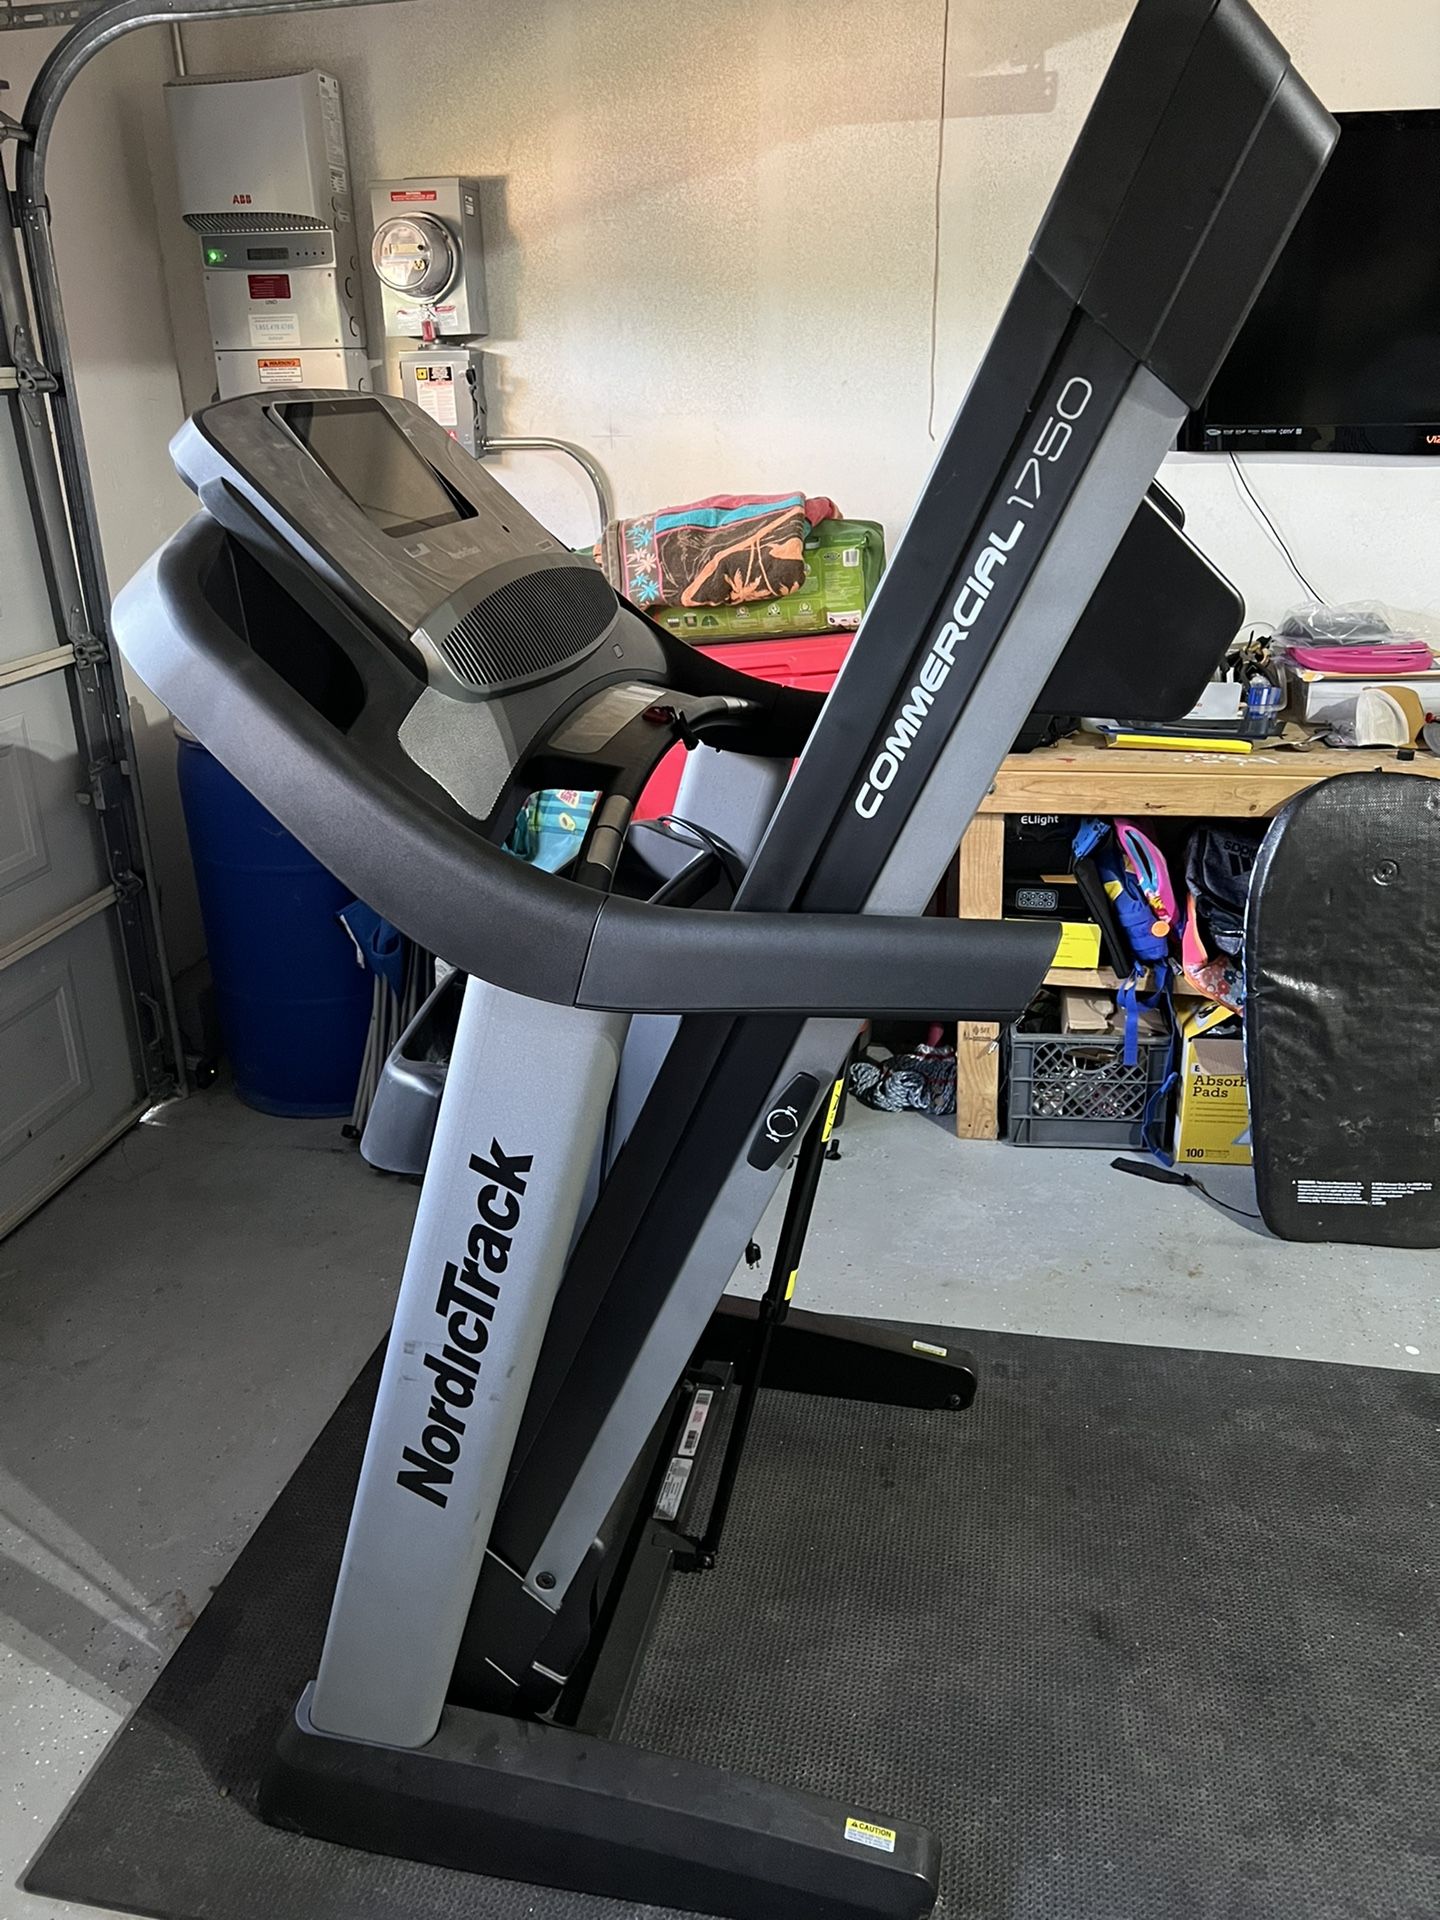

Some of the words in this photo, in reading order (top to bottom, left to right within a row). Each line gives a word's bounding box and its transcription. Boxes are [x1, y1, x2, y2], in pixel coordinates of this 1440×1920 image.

[233, 194, 252, 204] ABB
[855, 519, 1025, 819] COMMERCIAL
[1007, 376, 1092, 509] 1750
[1192, 1086, 1229, 1098] Pads
[1186, 1148, 1204, 1158] 100
[396, 1136, 534, 1510] NordicTrack
[859, 1823, 892, 1837] CAUTION
